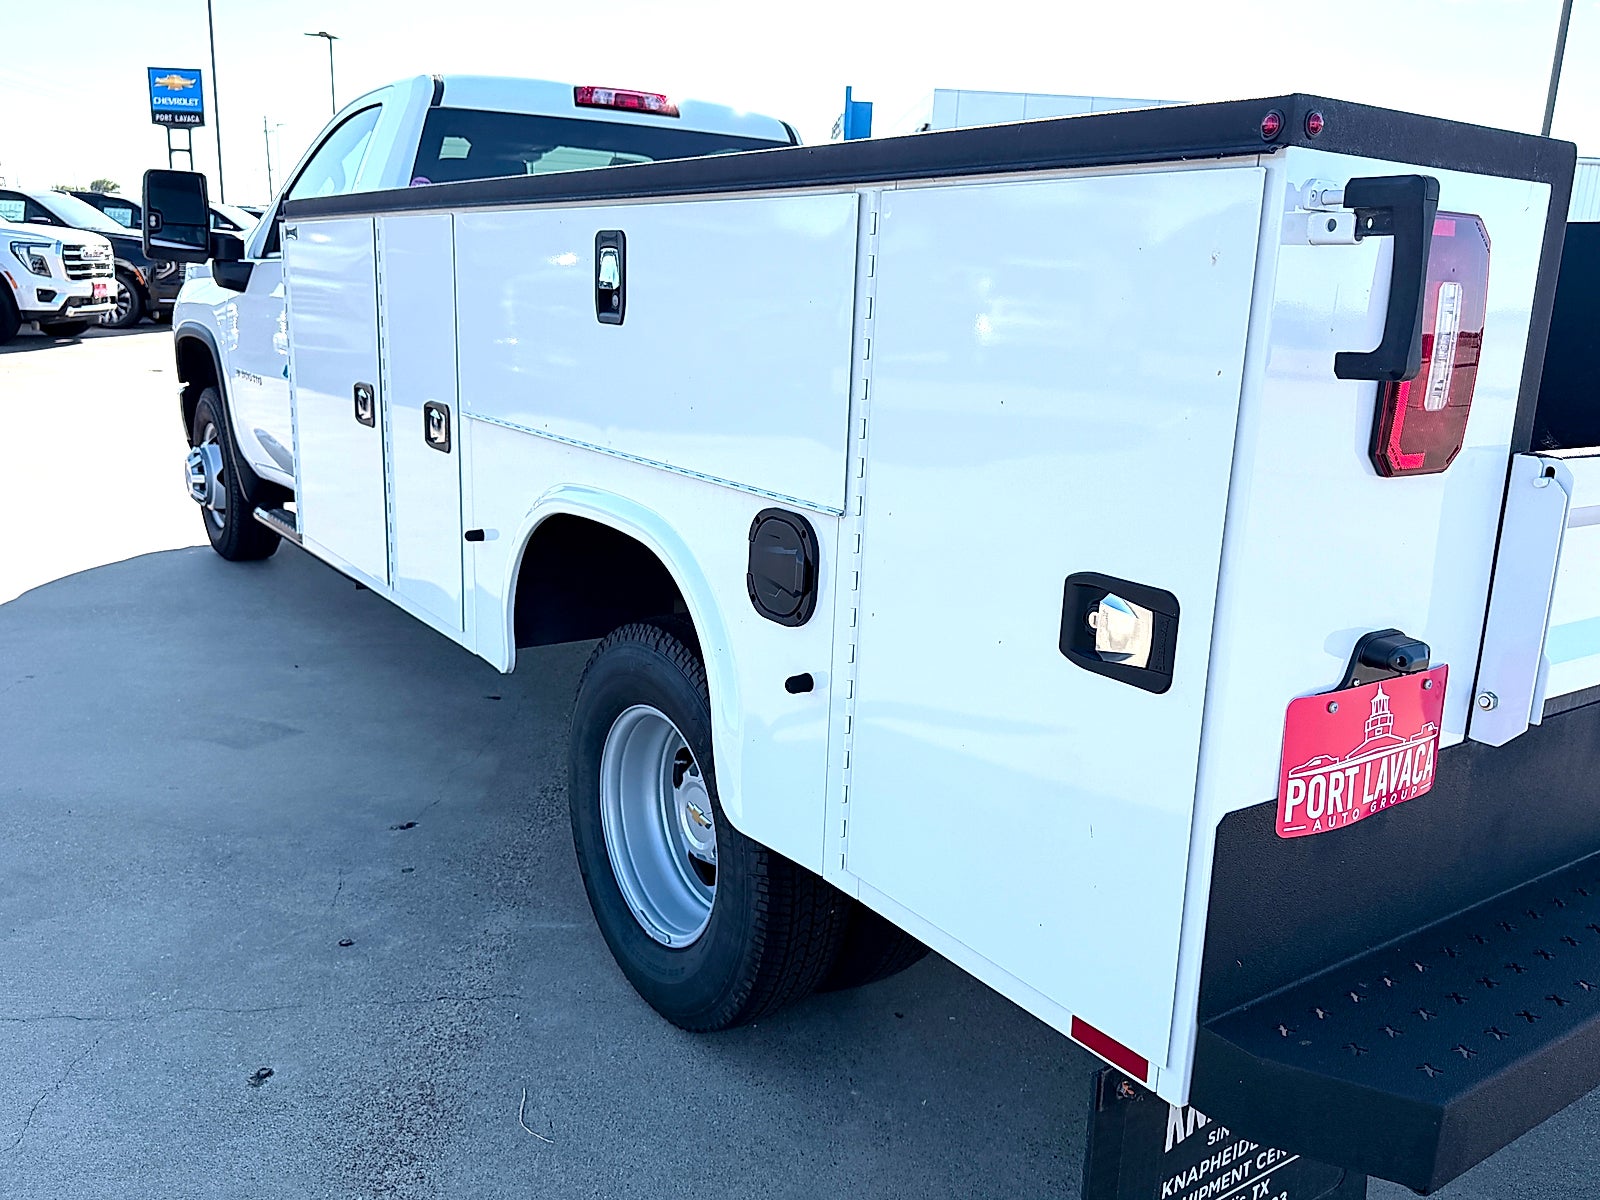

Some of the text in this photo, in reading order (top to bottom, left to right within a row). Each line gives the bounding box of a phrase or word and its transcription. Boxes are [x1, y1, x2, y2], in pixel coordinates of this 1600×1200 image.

[153, 96, 199, 106] CHEVROLET
[155, 113, 200, 123] PORT LAVACA
[1284, 739, 1435, 823] PORT LAVACA
[1312, 785, 1418, 831] AUTO GROUP
[1207, 1126, 1230, 1146] SIN
